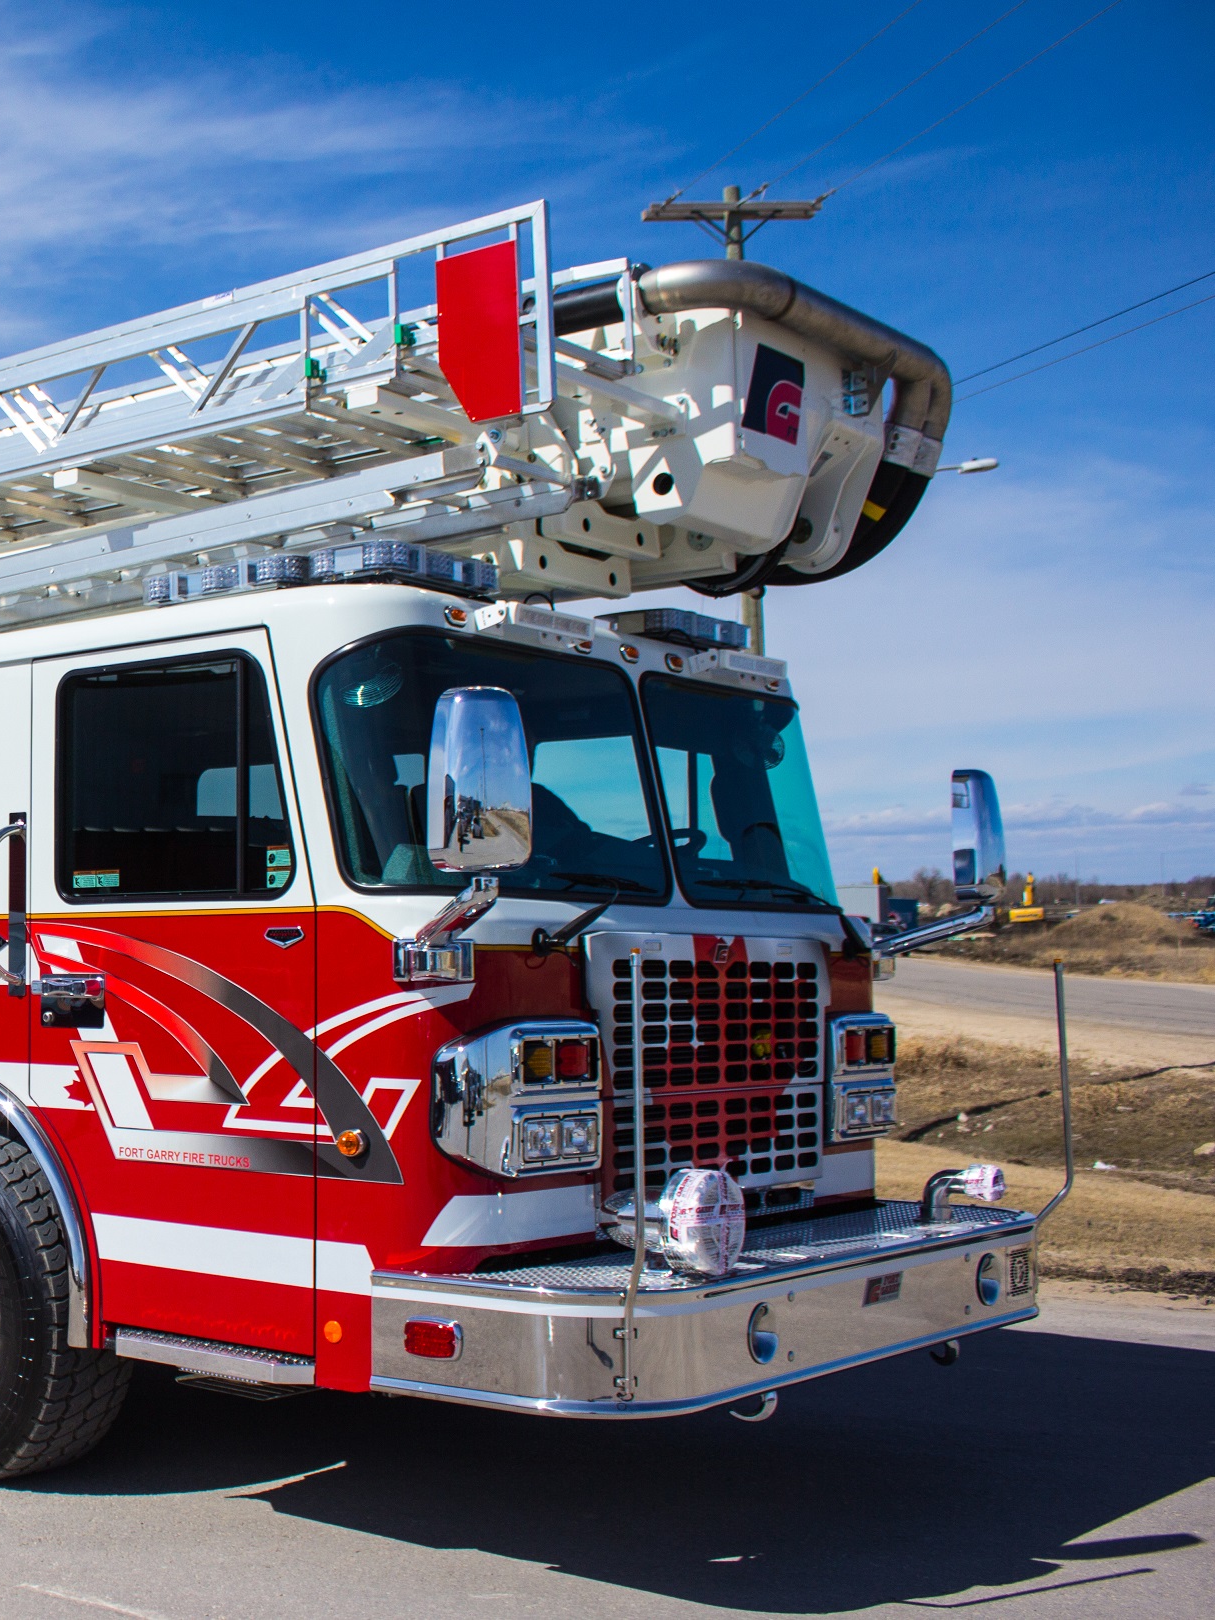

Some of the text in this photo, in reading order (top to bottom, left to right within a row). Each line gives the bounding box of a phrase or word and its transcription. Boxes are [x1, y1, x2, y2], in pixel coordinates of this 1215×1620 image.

[119, 1146, 251, 1168] FORT GARRY FIRE TRUCKS
